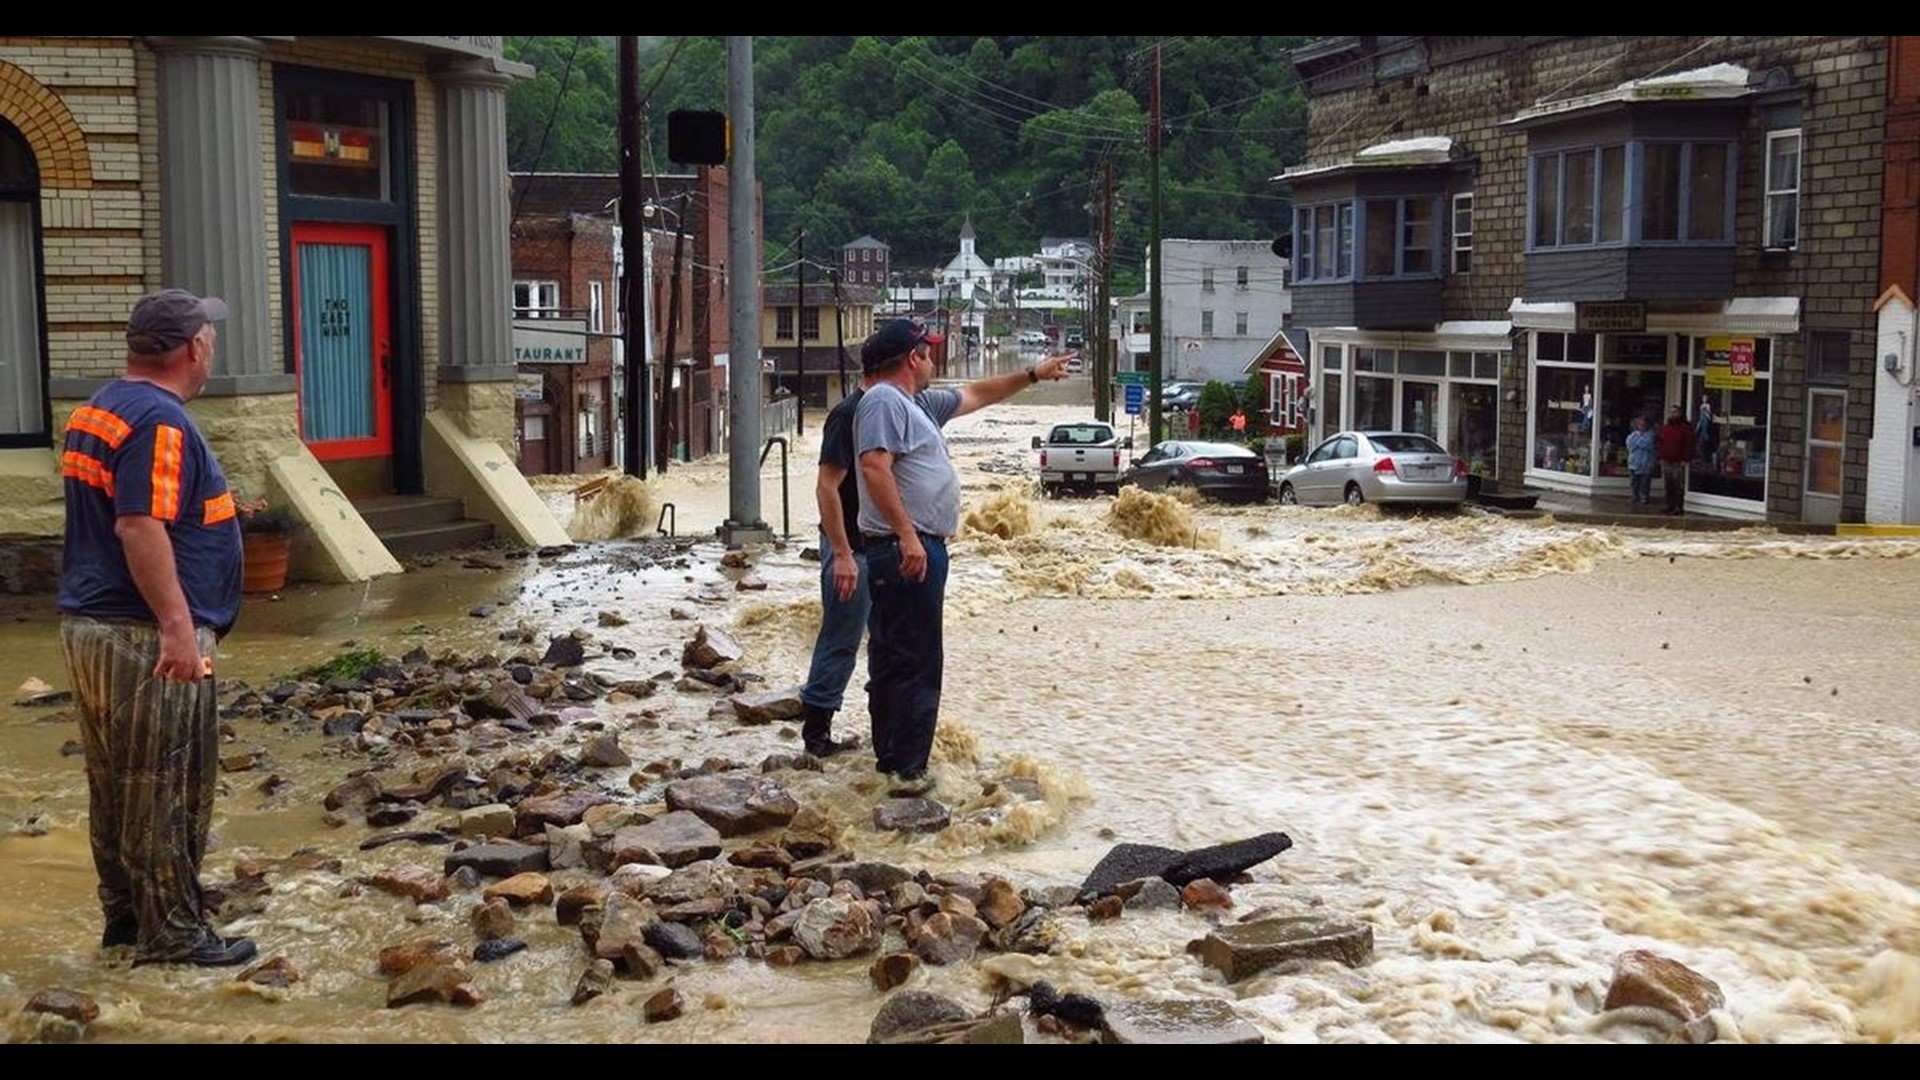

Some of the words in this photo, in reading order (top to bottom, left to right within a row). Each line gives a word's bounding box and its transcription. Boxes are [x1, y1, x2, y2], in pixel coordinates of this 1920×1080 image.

[325, 299, 348, 310] TWO
[321, 311, 350, 324] EAST
[323, 325, 350, 337] MAIN
[515, 347, 583, 360] TAURANT
[1732, 362, 1750, 375] UPS
